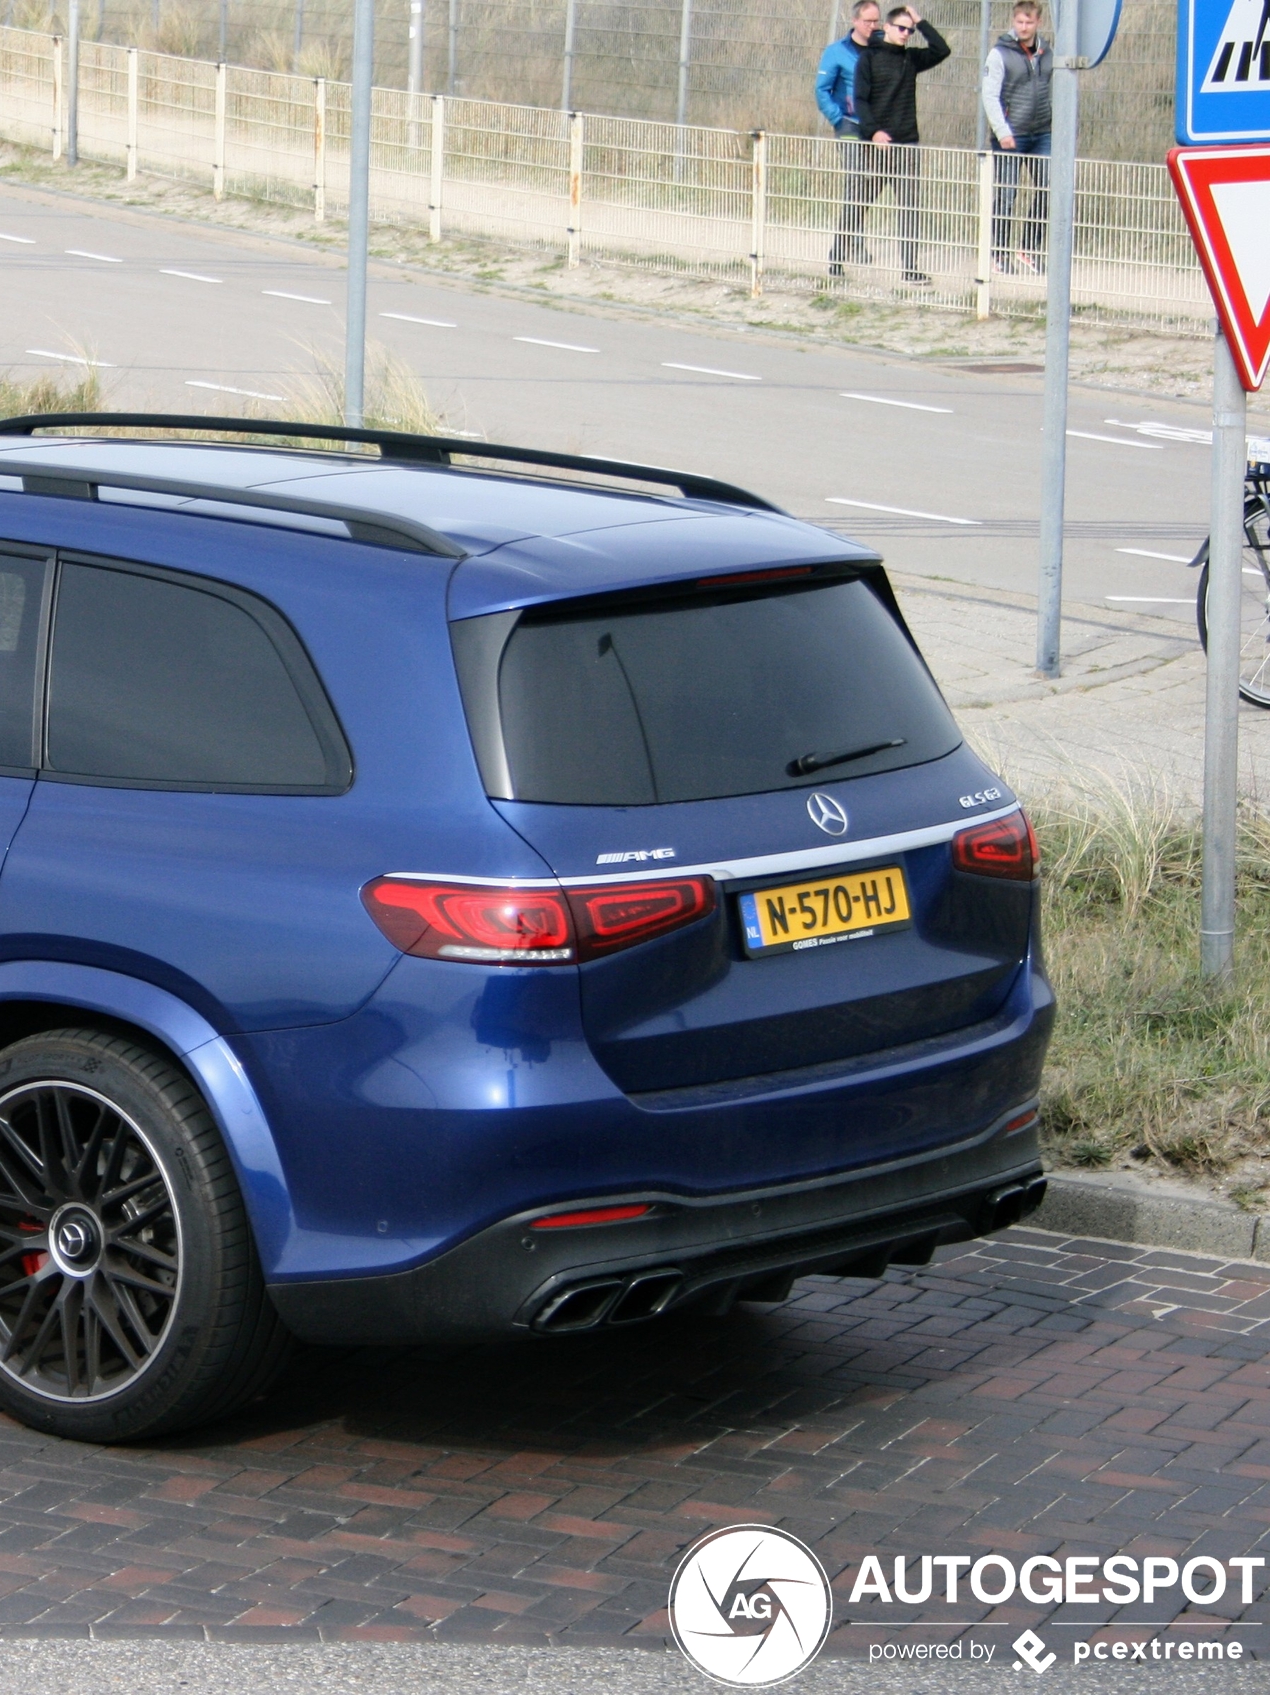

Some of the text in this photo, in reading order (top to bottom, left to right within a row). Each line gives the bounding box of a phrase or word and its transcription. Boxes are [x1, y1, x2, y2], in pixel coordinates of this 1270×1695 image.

[958, 787, 1001, 809] GLS 63
[622, 848, 675, 862] AMG
[766, 876, 897, 936] N-570-HJ
[746, 927, 760, 939] NL
[792, 938, 818, 950] GOMES
